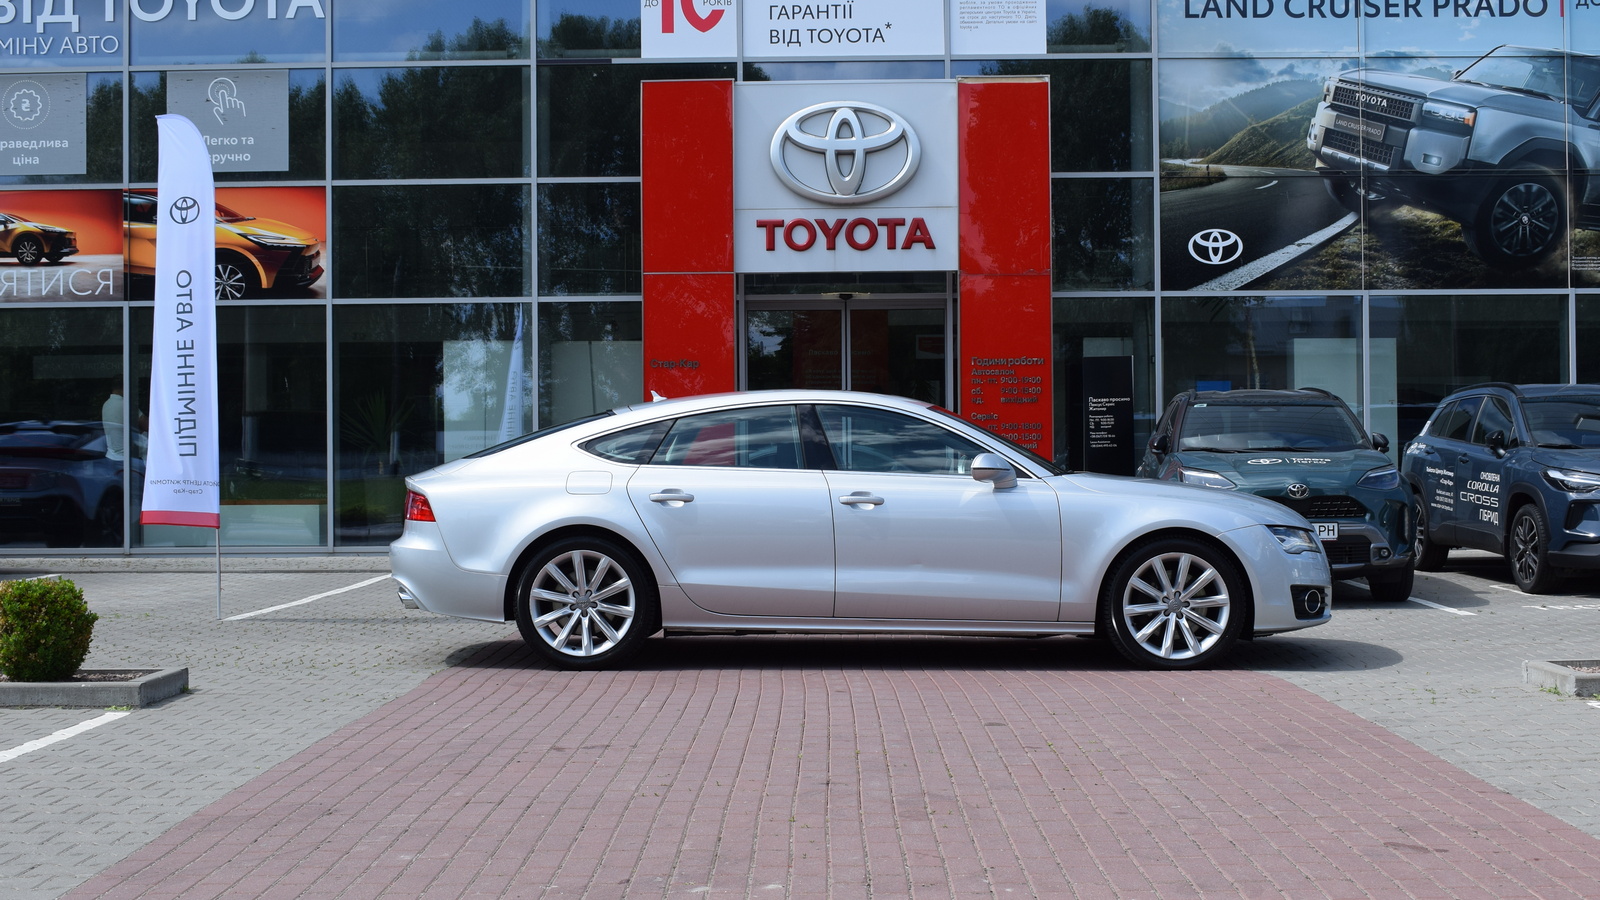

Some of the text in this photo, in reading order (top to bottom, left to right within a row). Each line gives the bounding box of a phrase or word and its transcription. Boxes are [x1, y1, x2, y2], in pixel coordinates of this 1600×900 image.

[769, 0, 853, 20] ГАРАНТІЇ
[1184, 0, 1548, 19] LAND CRUISER PRADO
[59, 35, 119, 54] АВТО
[769, 29, 802, 47] ВІД
[1355, 92, 1387, 107] TOYOTA
[241, 136, 254, 145] та
[12, 154, 40, 167] ціна
[208, 153, 251, 165] ручно
[756, 217, 936, 252] TOYOTA
[650, 358, 701, 371] Стар-Кар
[971, 356, 1044, 367] Години роботи
[971, 368, 1015, 376] Автосалон
[971, 412, 998, 421] Сервіс
[1467, 480, 1500, 493] COROLLA
[1460, 491, 1499, 507] CROSS
